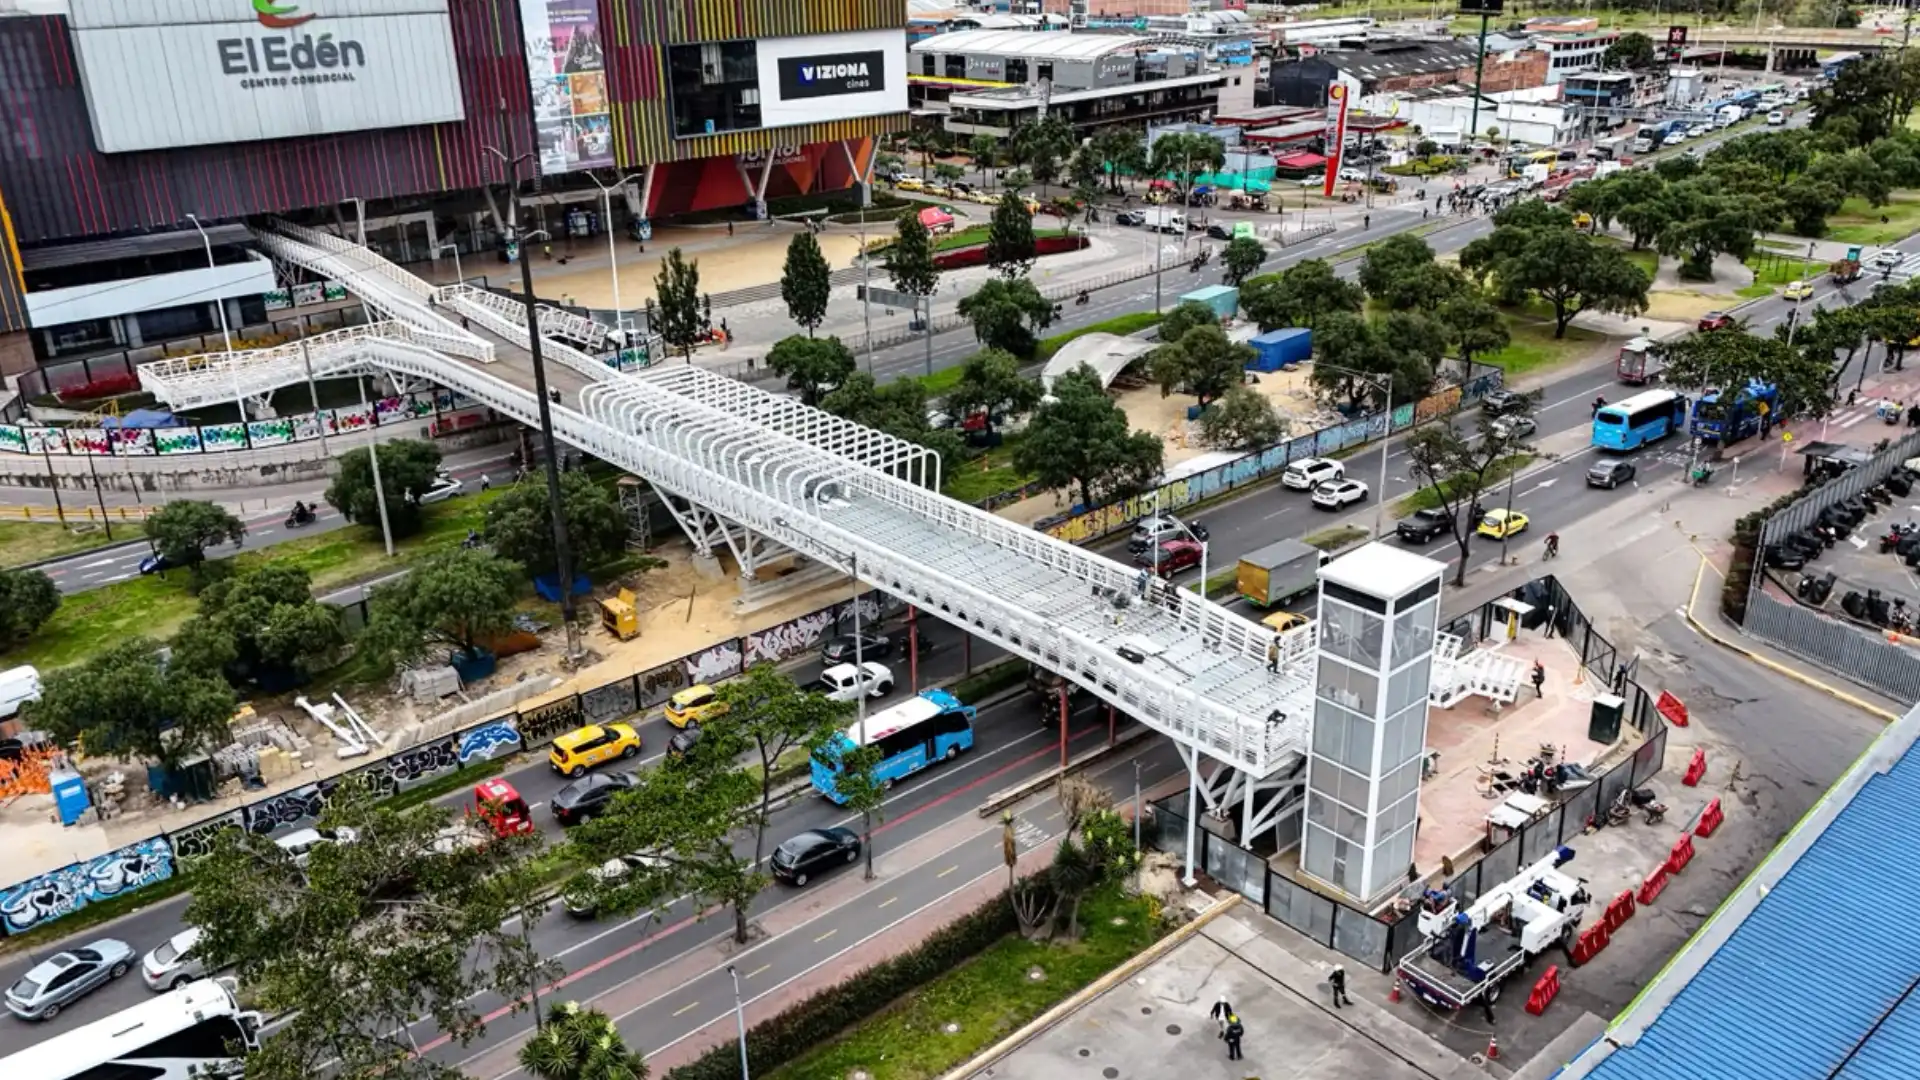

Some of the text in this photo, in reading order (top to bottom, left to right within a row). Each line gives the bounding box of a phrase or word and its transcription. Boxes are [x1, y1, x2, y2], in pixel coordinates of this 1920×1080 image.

[217, 32, 365, 75] El Edén
[240, 72, 356, 89] CENTRO COMERCIAL
[802, 62, 869, 81] VIZIONA
[846, 79, 870, 88] cines
